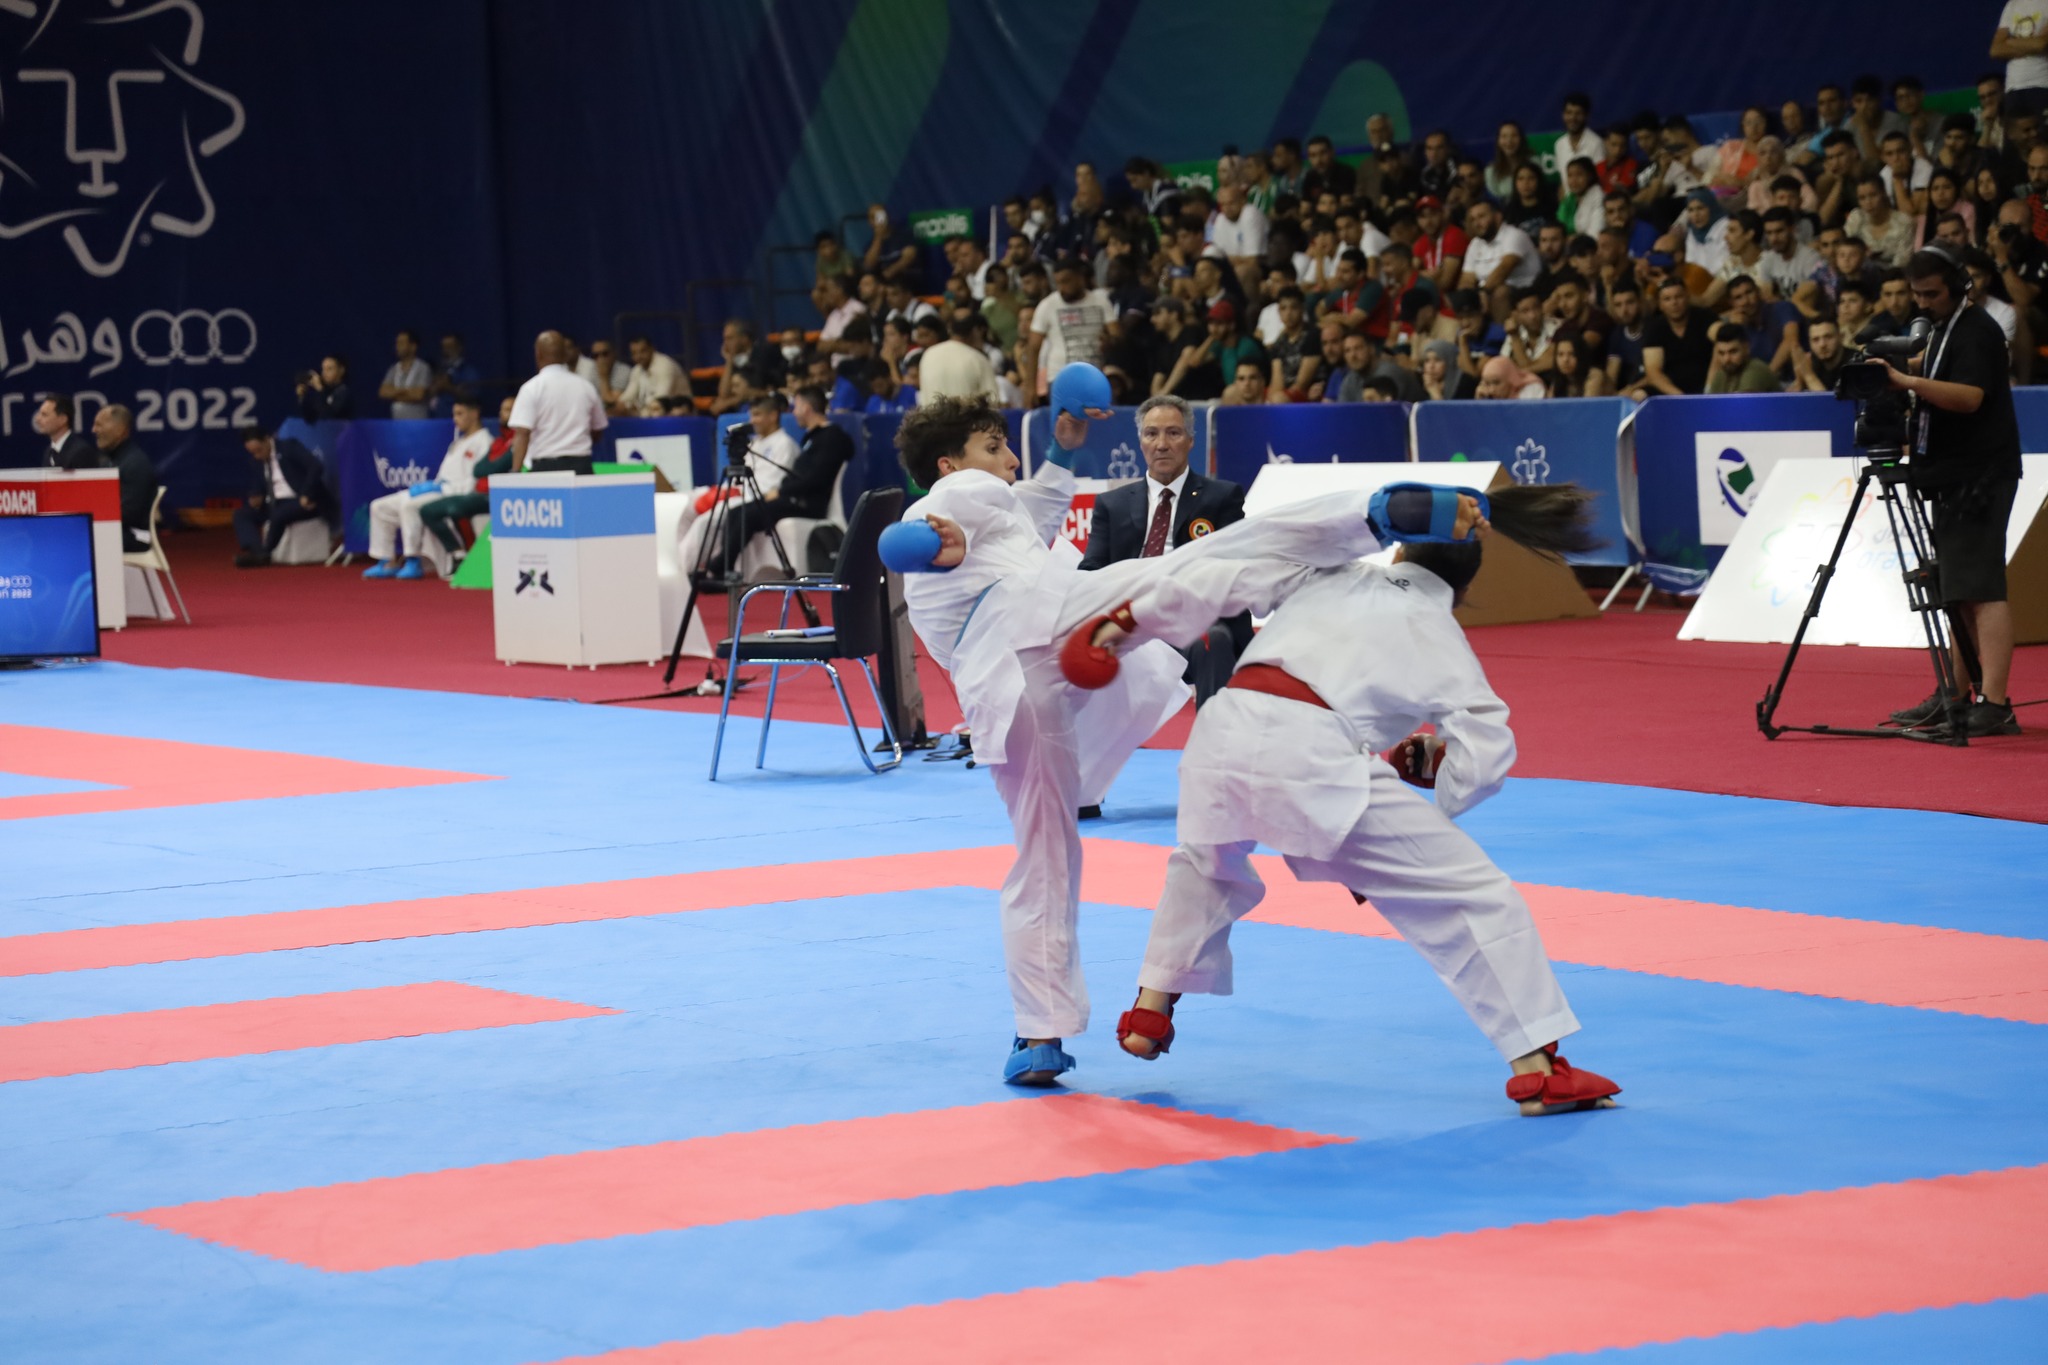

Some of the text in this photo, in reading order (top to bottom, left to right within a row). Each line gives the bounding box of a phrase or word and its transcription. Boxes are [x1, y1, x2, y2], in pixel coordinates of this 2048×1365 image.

[135, 387, 258, 431] 2022
[373, 452, 429, 488] Condor
[501, 498, 563, 527] COACH
